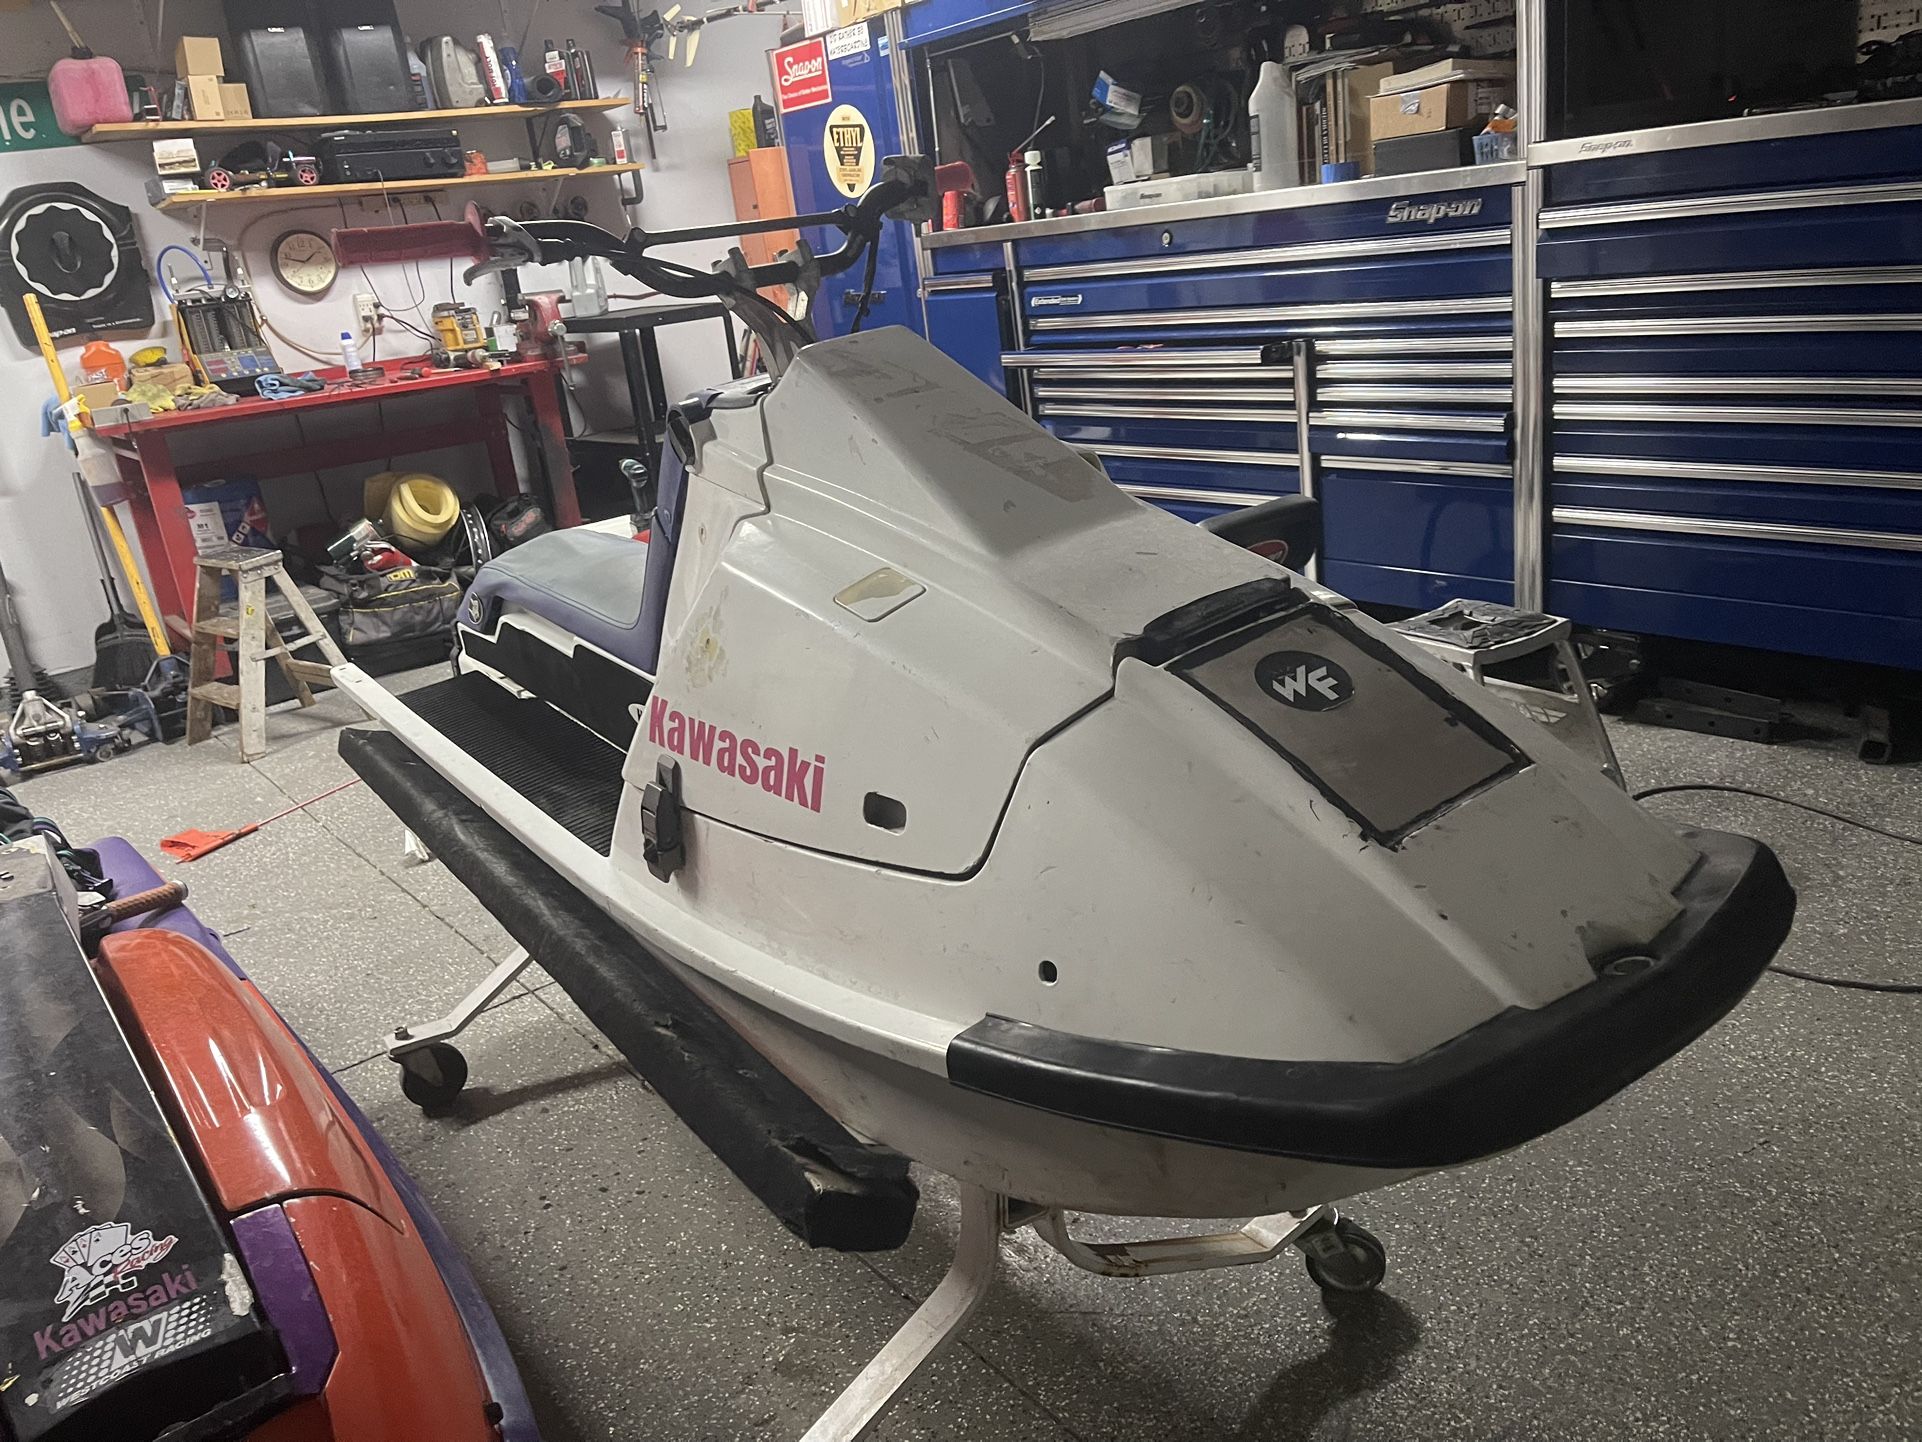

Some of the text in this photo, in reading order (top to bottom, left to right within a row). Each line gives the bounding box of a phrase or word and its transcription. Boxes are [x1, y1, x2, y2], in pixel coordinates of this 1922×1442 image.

[781, 56, 823, 87] Snap-on
[832, 127, 863, 147] ETHYL
[1579, 140, 1633, 153] Snap-on
[1386, 198, 1482, 224] Snap-on
[649, 695, 826, 813] Kawasaki
[56, 1231, 151, 1302] Aces
[33, 1264, 199, 1360] Kawasaki
[154, 1328, 212, 1359] RACING
